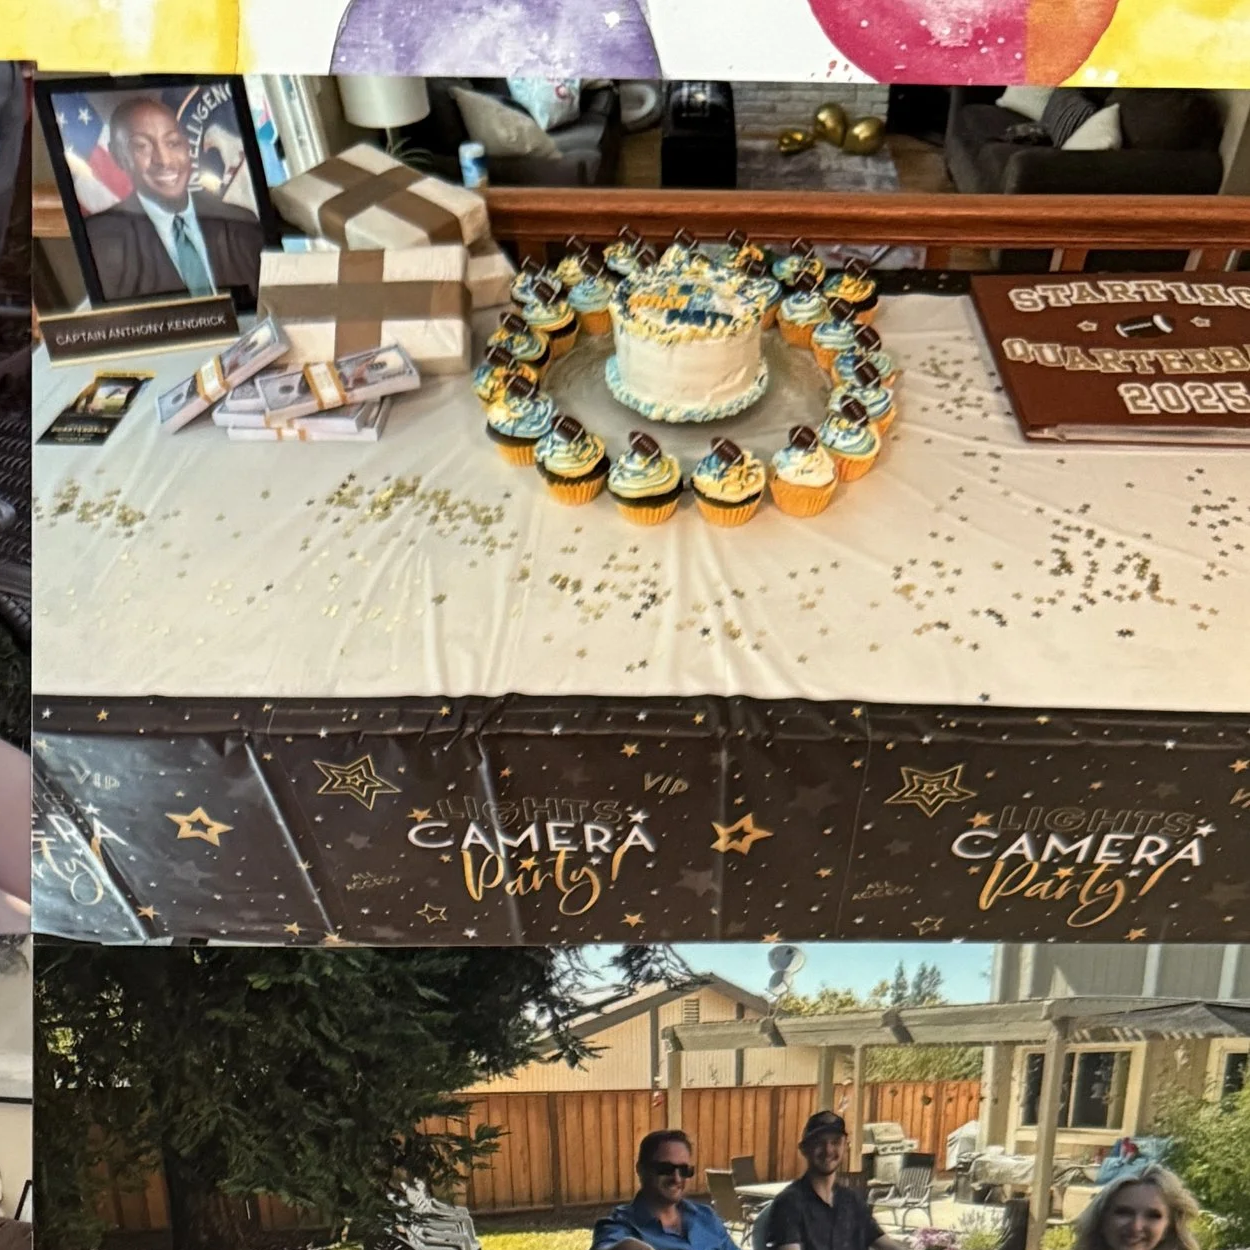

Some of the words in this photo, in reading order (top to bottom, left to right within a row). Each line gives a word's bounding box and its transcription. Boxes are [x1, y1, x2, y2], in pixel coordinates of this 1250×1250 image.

[55, 331, 107, 346] CAPTAIN
[108, 322, 164, 340] ANTHONY
[166, 315, 226, 332] KENDRICK
[1001, 337, 1250, 375] QUARTERB
[1117, 381, 1250, 414] 2025
[644, 773, 688, 795] VIP
[436, 796, 623, 828] LIGHTS
[997, 805, 1196, 838] LIGHTS
[407, 821, 656, 858] CAMERA
[951, 830, 1203, 867] CAMERA
